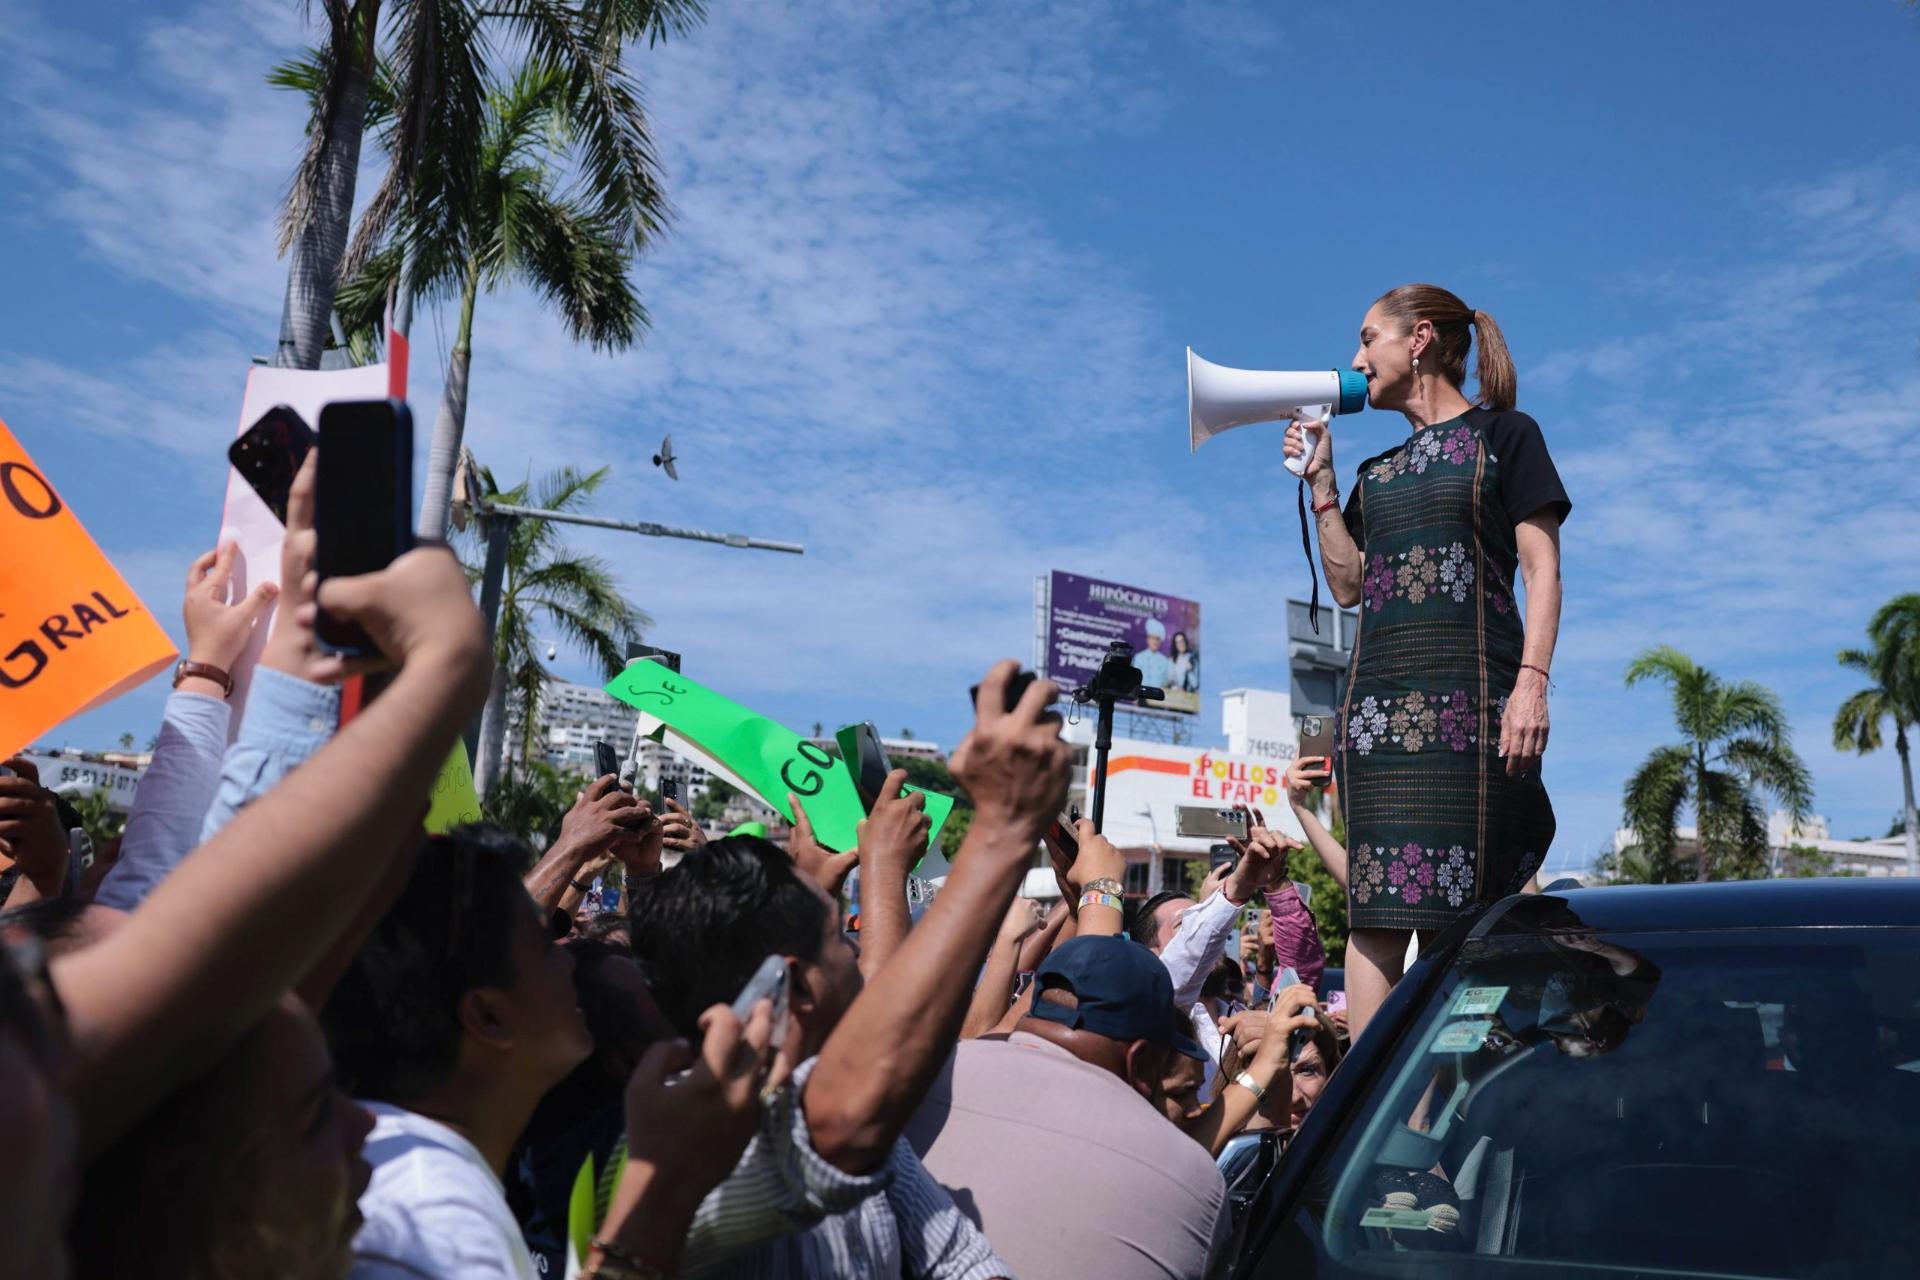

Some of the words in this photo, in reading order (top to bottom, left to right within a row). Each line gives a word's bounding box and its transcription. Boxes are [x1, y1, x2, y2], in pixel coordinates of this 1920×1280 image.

[1089, 584, 1168, 610] HIPÓCRATES
[1248, 738, 1296, 760] 744592
[1199, 757, 1277, 786] POLLOS
[1193, 779, 1213, 799] EL
[1221, 782, 1278, 806] PAPO
